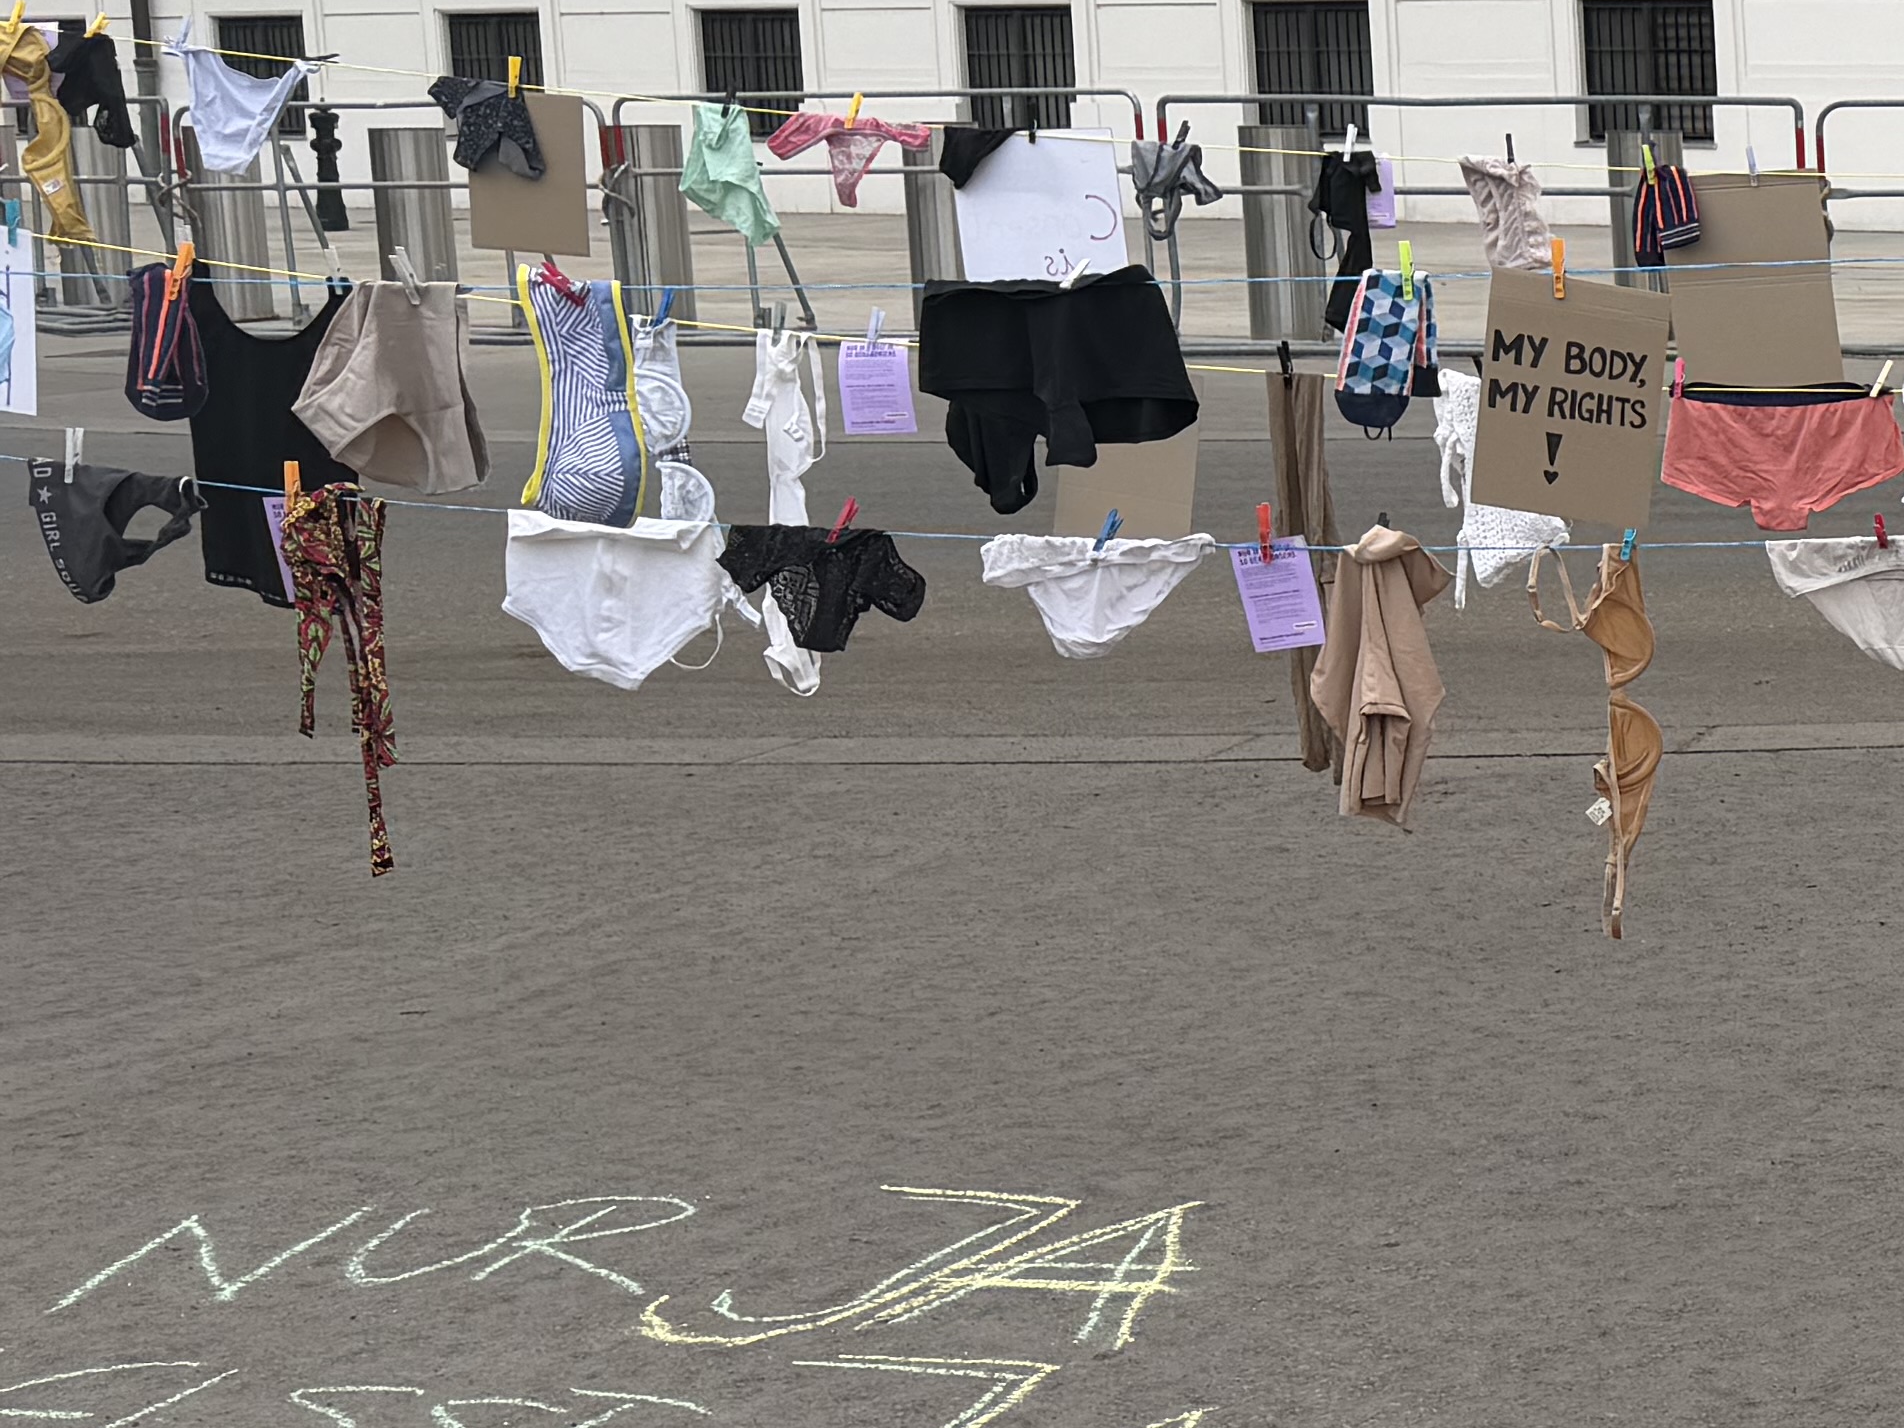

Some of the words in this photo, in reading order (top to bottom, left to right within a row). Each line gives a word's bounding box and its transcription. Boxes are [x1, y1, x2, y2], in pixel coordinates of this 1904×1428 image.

[1491, 328, 1549, 368] MY
[1564, 340, 1649, 389] BODY,
[1487, 378, 1541, 414] MY
[1547, 386, 1648, 430] RIGHTS
[40, 511, 62, 553] GIRL
[44, 1192, 704, 1318] NUR
[638, 1182, 1208, 1352] JA
